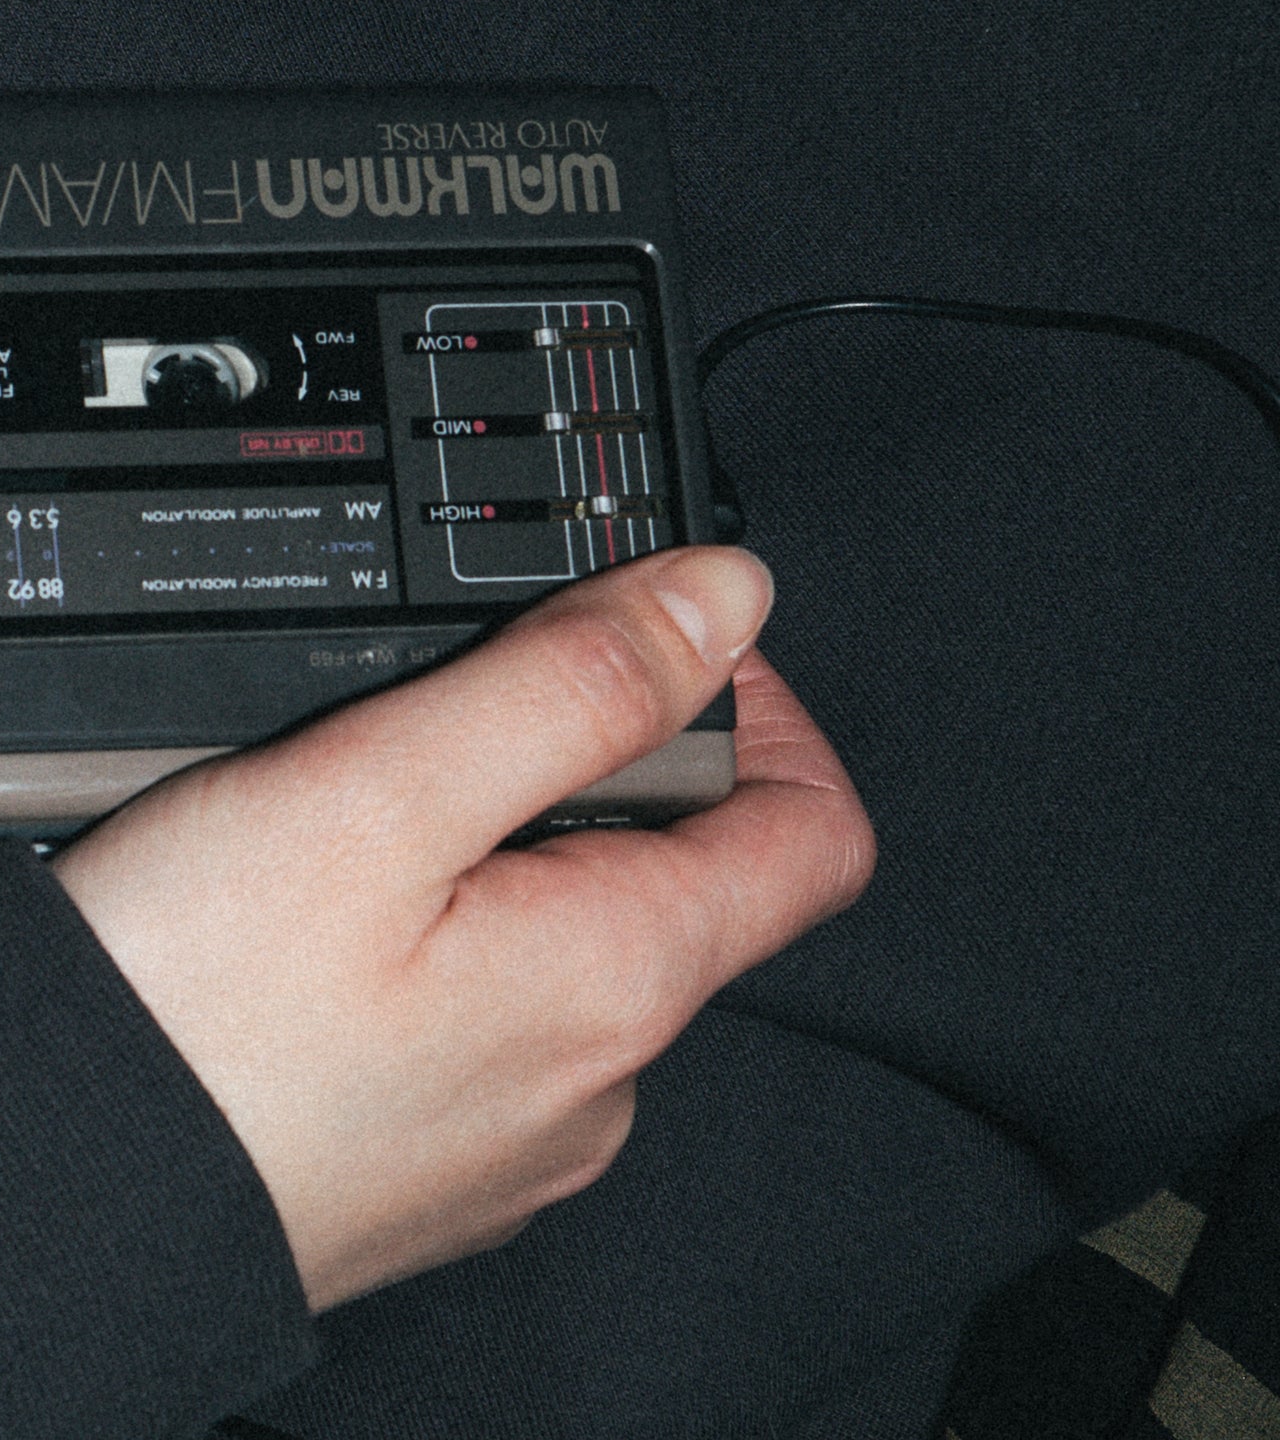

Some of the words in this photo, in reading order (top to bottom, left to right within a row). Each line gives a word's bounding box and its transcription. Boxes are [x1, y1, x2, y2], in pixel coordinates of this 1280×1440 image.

[377, 121, 506, 150] REVERSE
[518, 120, 608, 147] AUTO
[256, 153, 621, 219] WALKMAN
[315, 331, 355, 344] FWD
[416, 336, 463, 351] LOW
[328, 389, 361, 401] REV
[432, 420, 471, 435] MID
[142, 509, 236, 522] MODULATION
[242, 507, 321, 520] AMPLITUDE
[344, 501, 382, 520] AM
[430, 506, 481, 521] HIGH
[6, 509, 22, 529] 6
[29, 508, 59, 529] 5.3
[329, 541, 375, 553] SCALE
[142, 578, 237, 592] MODULATION
[242, 575, 328, 589] FREQUENCY
[351, 569, 388, 589] FM
[7, 579, 35, 601] 92
[38, 578, 64, 600] 88
